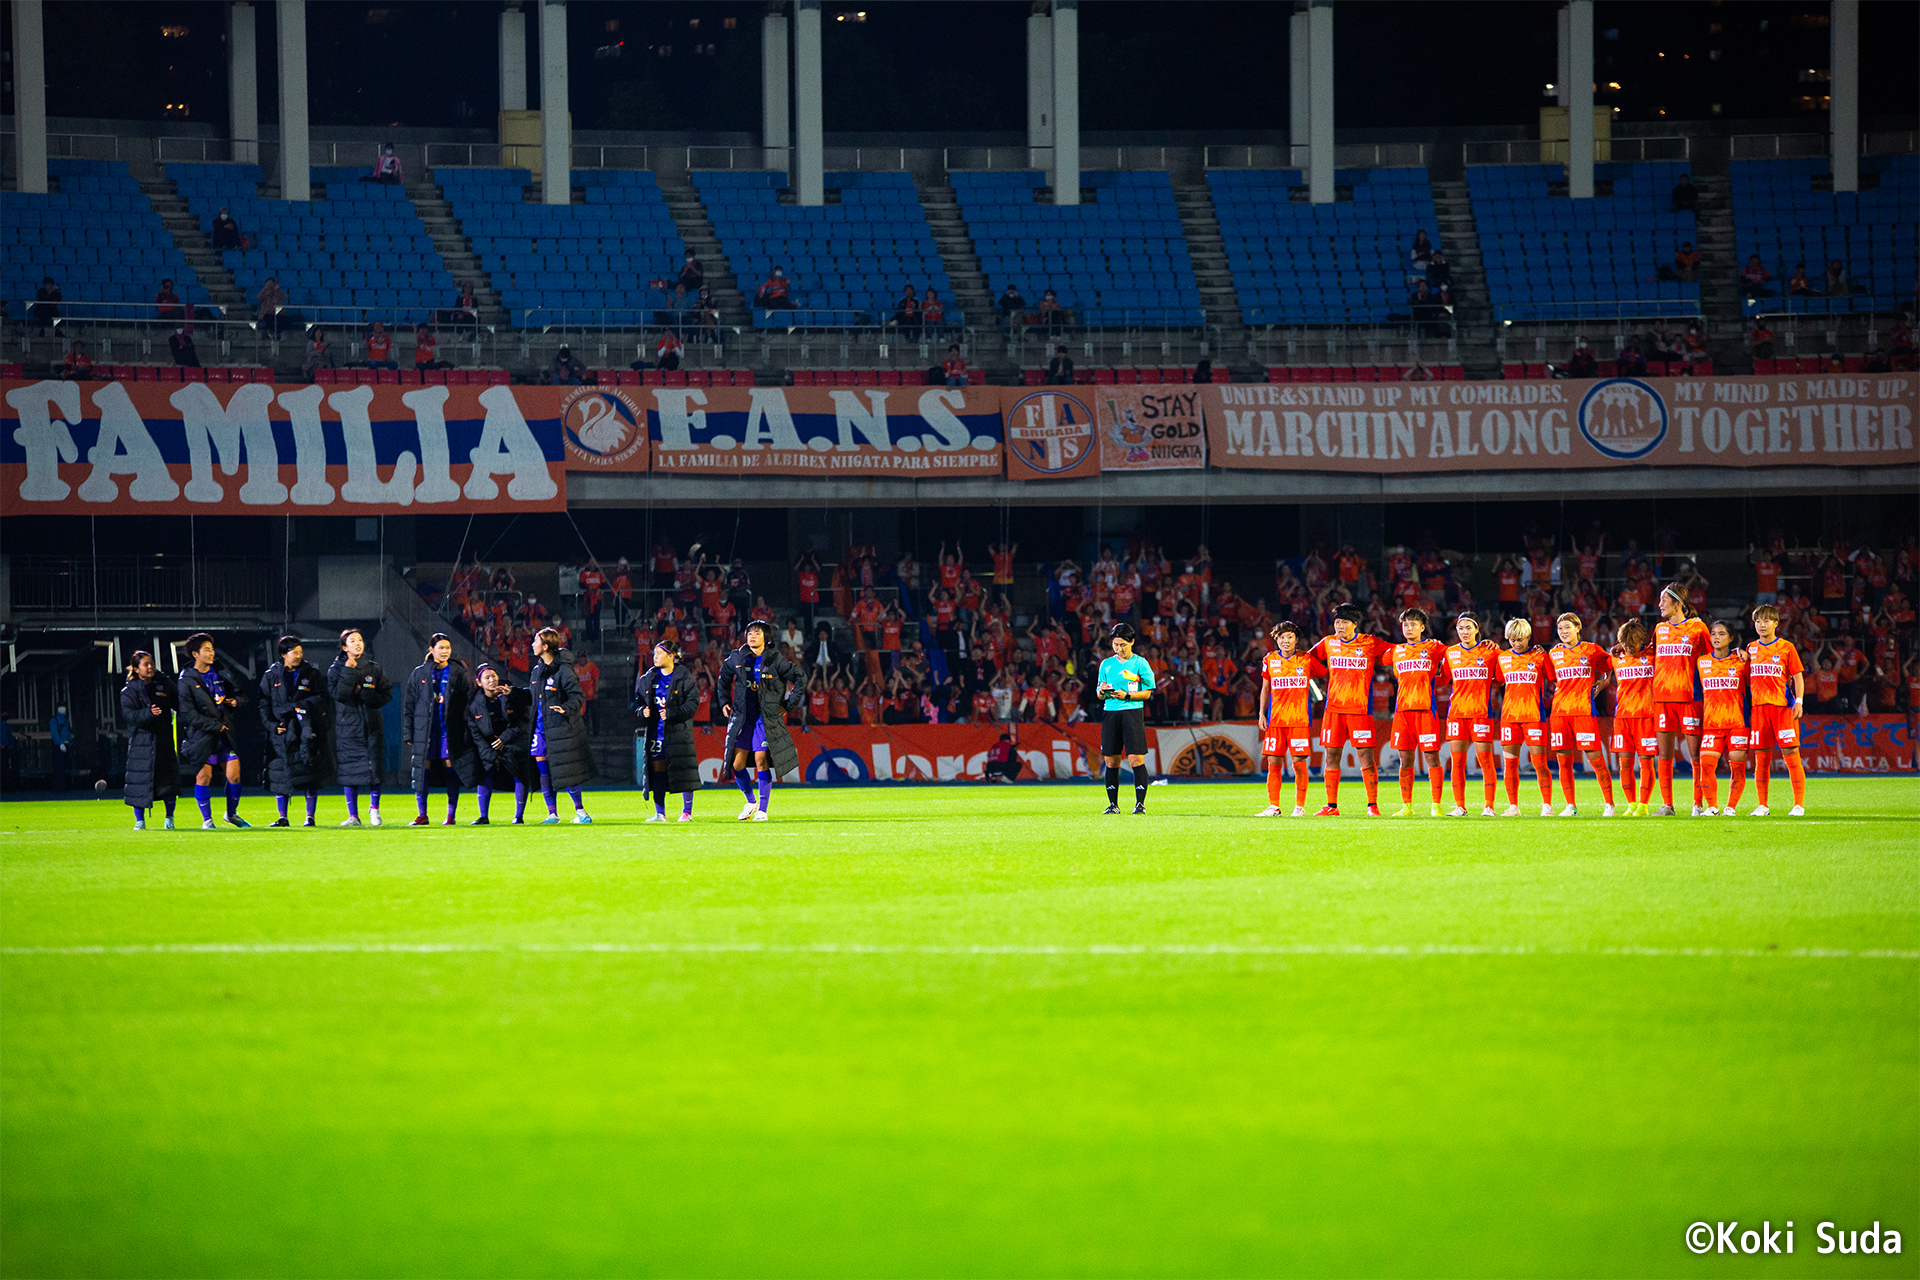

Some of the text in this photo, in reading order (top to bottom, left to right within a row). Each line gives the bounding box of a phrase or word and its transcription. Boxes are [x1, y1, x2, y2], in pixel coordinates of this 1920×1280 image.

[1220, 385, 1568, 406] UNITE&STAND UP MY COMRADES.
[1674, 382, 1705, 401] MY
[1714, 383, 1769, 403] MIND
[1778, 382, 1798, 401] IS
[1806, 379, 1870, 399] MADE
[1141, 393, 1197, 419] STAY
[651, 388, 996, 452] F.A.N.S.
[1020, 426, 1083, 437] BRIGADA
[1151, 423, 1200, 439] GOLD
[1674, 404, 1914, 455] TOGETHER
[5, 380, 558, 506] FAMILIA
[1152, 445, 1202, 460] NIIGATA
[658, 454, 998, 469] LA FAMILIA DE ALBIREX NIIGATA PARA SIEMPRE
[1322, 729, 1331, 743] 11
[1448, 722, 1459, 736] 18
[1501, 727, 1511, 741] 19
[650, 740, 663, 753] 23
[1265, 737, 1276, 752] 13
[1551, 733, 1563, 747] 20
[1614, 734, 1623, 748] 10
[1701, 734, 1715, 748] 23
